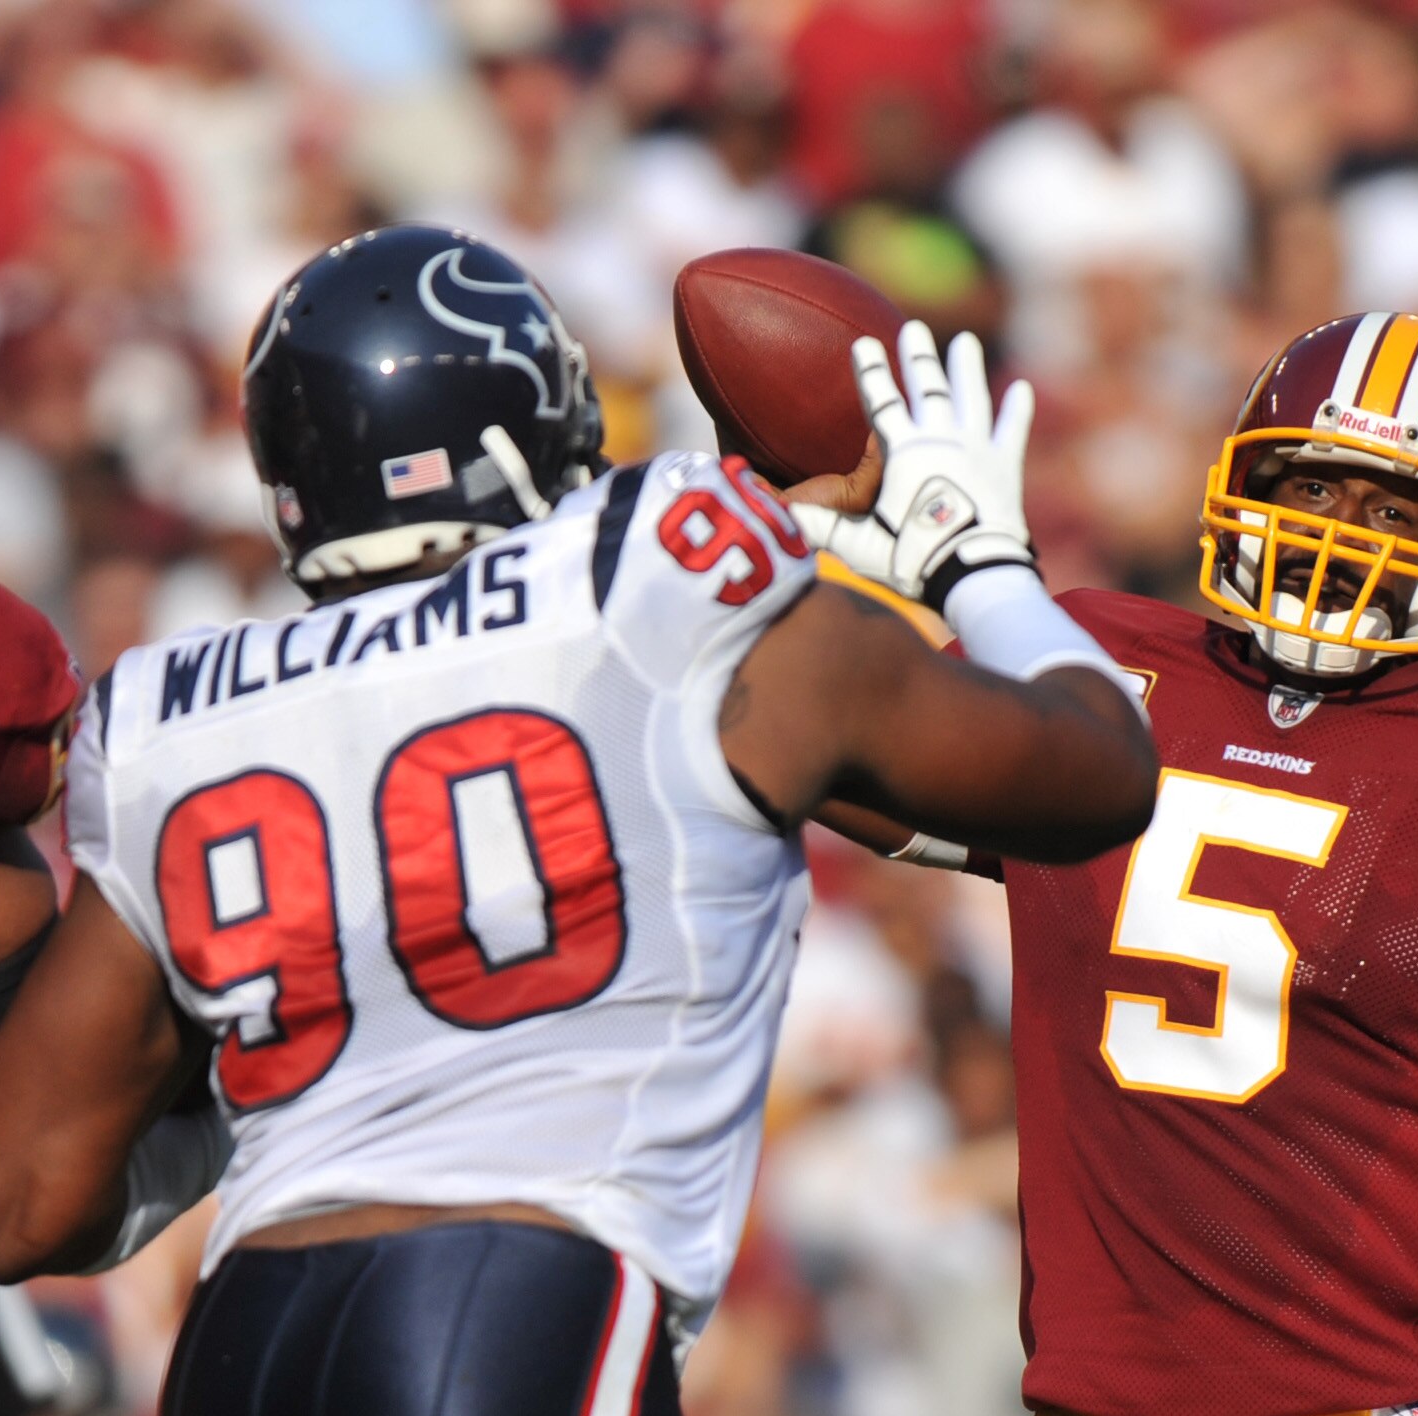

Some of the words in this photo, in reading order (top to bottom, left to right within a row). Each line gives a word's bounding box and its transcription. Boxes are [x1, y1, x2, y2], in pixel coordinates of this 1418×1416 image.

[159, 546, 527, 723] WILLIAMS
[1222, 743, 1318, 775] REDSKINS
[154, 704, 628, 1114] 90
[1099, 766, 1350, 1104] 5
